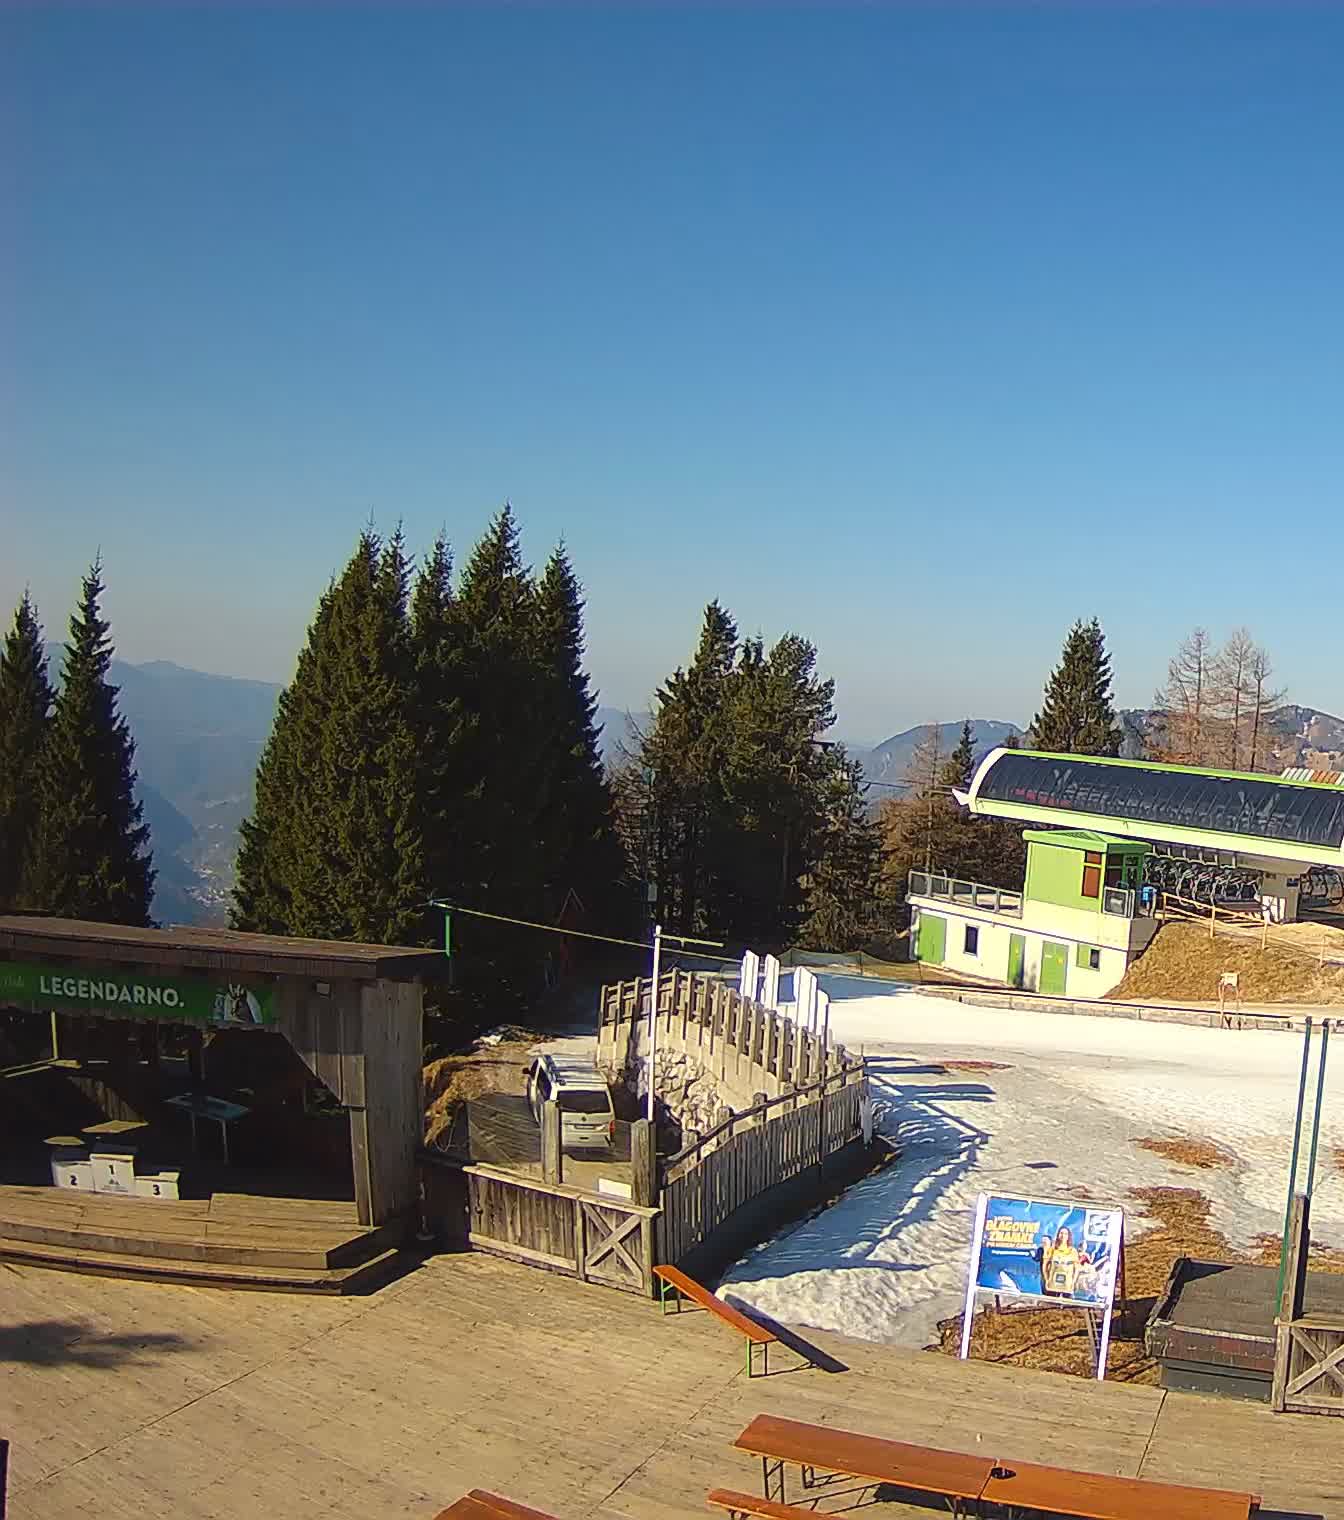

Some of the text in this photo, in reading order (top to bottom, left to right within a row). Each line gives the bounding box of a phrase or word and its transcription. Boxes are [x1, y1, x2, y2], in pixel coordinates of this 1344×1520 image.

[108, 1164, 115, 1175] 1
[70, 1175, 78, 1186] 2
[152, 1184, 161, 1196] 3
